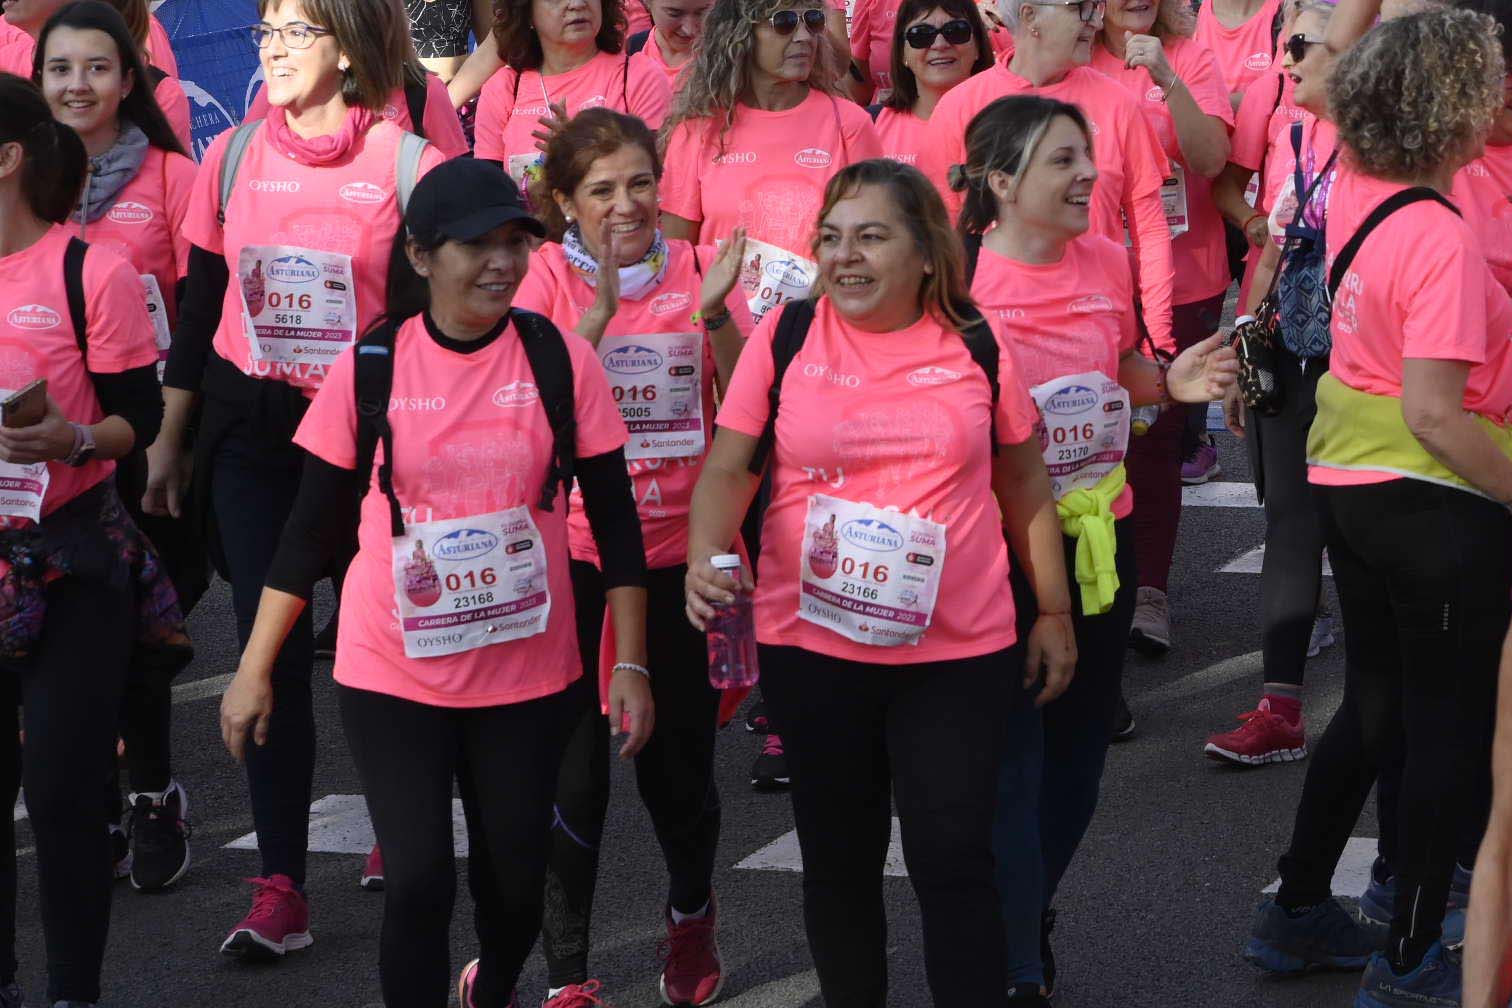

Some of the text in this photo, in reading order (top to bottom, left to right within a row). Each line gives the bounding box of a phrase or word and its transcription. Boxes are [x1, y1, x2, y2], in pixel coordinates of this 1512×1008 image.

[248, 178, 301, 193] OYSHO
[268, 291, 312, 310] 016
[274, 313, 302, 325] 5618
[607, 356, 658, 369] ASTURIANA
[611, 384, 657, 402] 016
[618, 406, 651, 418] 5005
[1052, 422, 1094, 444] 016
[651, 438, 695, 449] Santander
[1058, 446, 1089, 461] 23170
[847, 526, 899, 549] ASTURIANA
[841, 556, 890, 583] 016
[445, 567, 497, 592] 016
[841, 581, 879, 600] 23166
[453, 591, 494, 610] 23168
[841, 599, 852, 609] DE
[853, 602, 864, 612] LA
[865, 605, 895, 618] MUJER
[418, 615, 459, 628] CARRERA
[460, 613, 473, 622] DE
[474, 610, 487, 620] LA
[487, 605, 517, 618] MUJER
[416, 633, 463, 649] OYSHO
